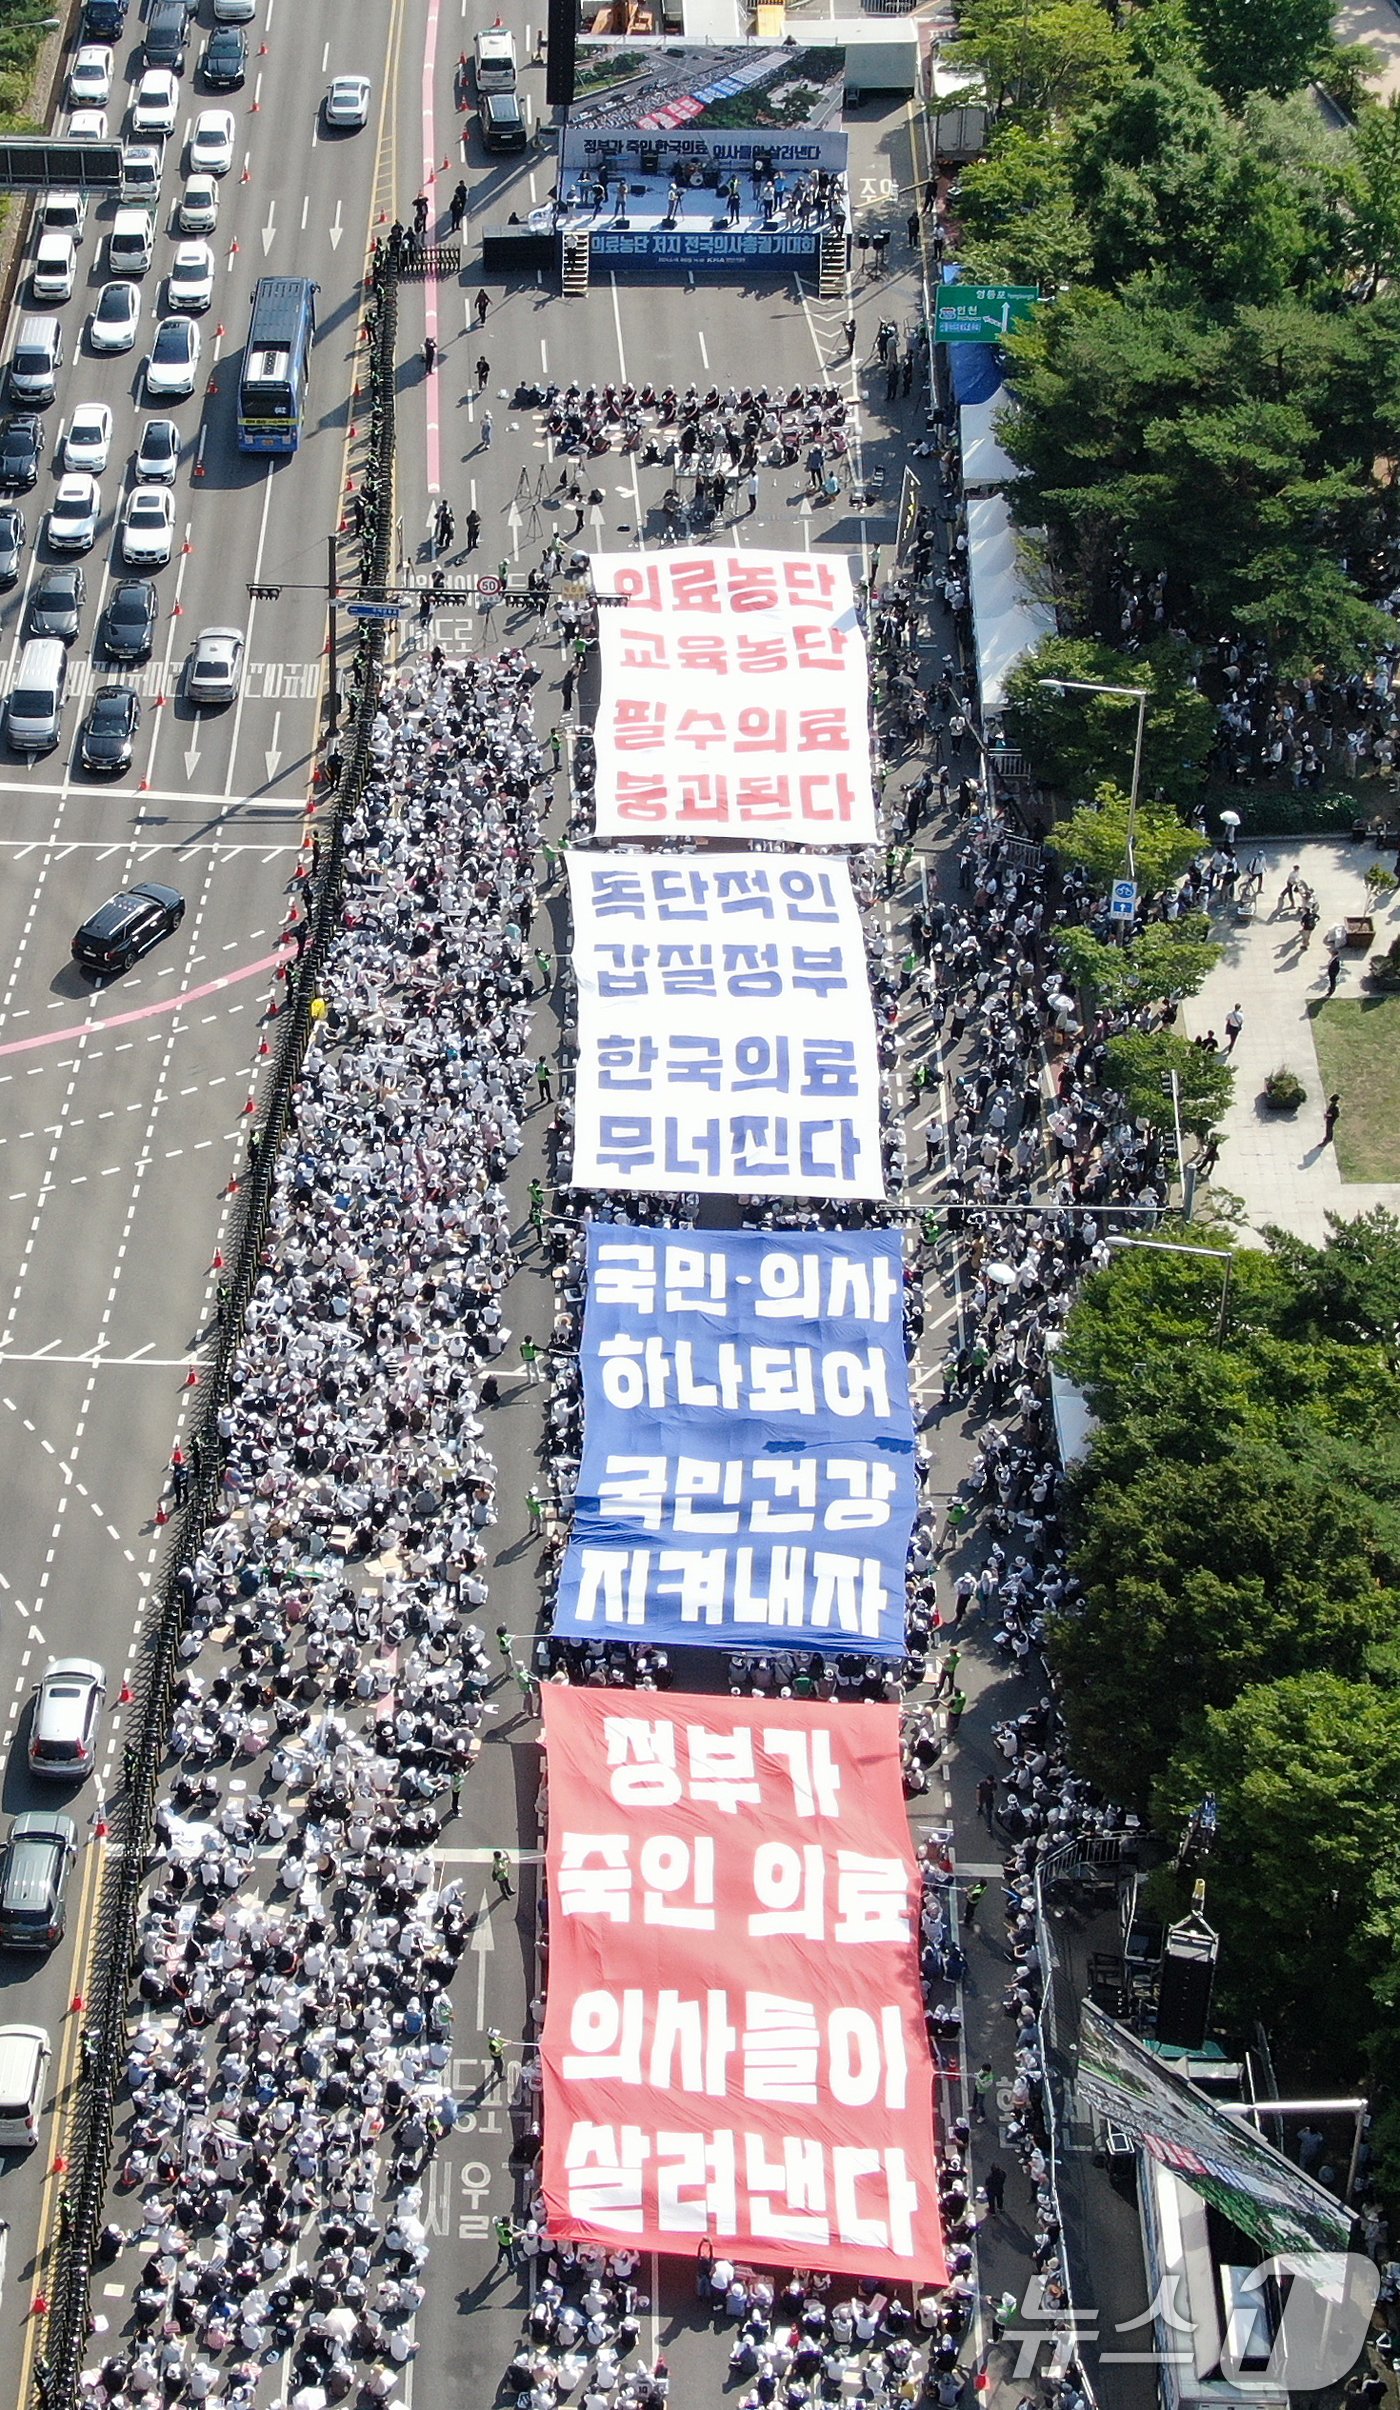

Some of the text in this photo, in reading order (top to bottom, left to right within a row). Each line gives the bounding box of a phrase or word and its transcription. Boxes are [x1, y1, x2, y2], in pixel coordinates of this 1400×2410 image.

[584, 139, 624, 155] 정부가
[655, 139, 709, 155] 한국의료
[591, 234, 815, 254] 의료농단 저지 전국의사총궐기대회
[482, 580, 497, 592] 50
[614, 558, 836, 614] 의료농단
[619, 625, 849, 675] 교육농단
[613, 699, 851, 754] 필수의료
[614, 771, 856, 823] 붕괴된다
[591, 870, 840, 924] 독단적인
[594, 943, 849, 998] 갑질정부
[597, 1034, 859, 1097] 한국의료
[596, 1115, 862, 1181] 무너진다
[597, 1334, 892, 1418] 하나되어
[597, 1455, 897, 1535] 국민건강
[574, 1545, 889, 1639] 지켜내자
[602, 1716, 842, 1818] 정부가
[557, 1831, 911, 1944] 죽인 의료
[561, 1989, 909, 2109] 의사들이
[563, 2120, 919, 2257] 살려낸다
